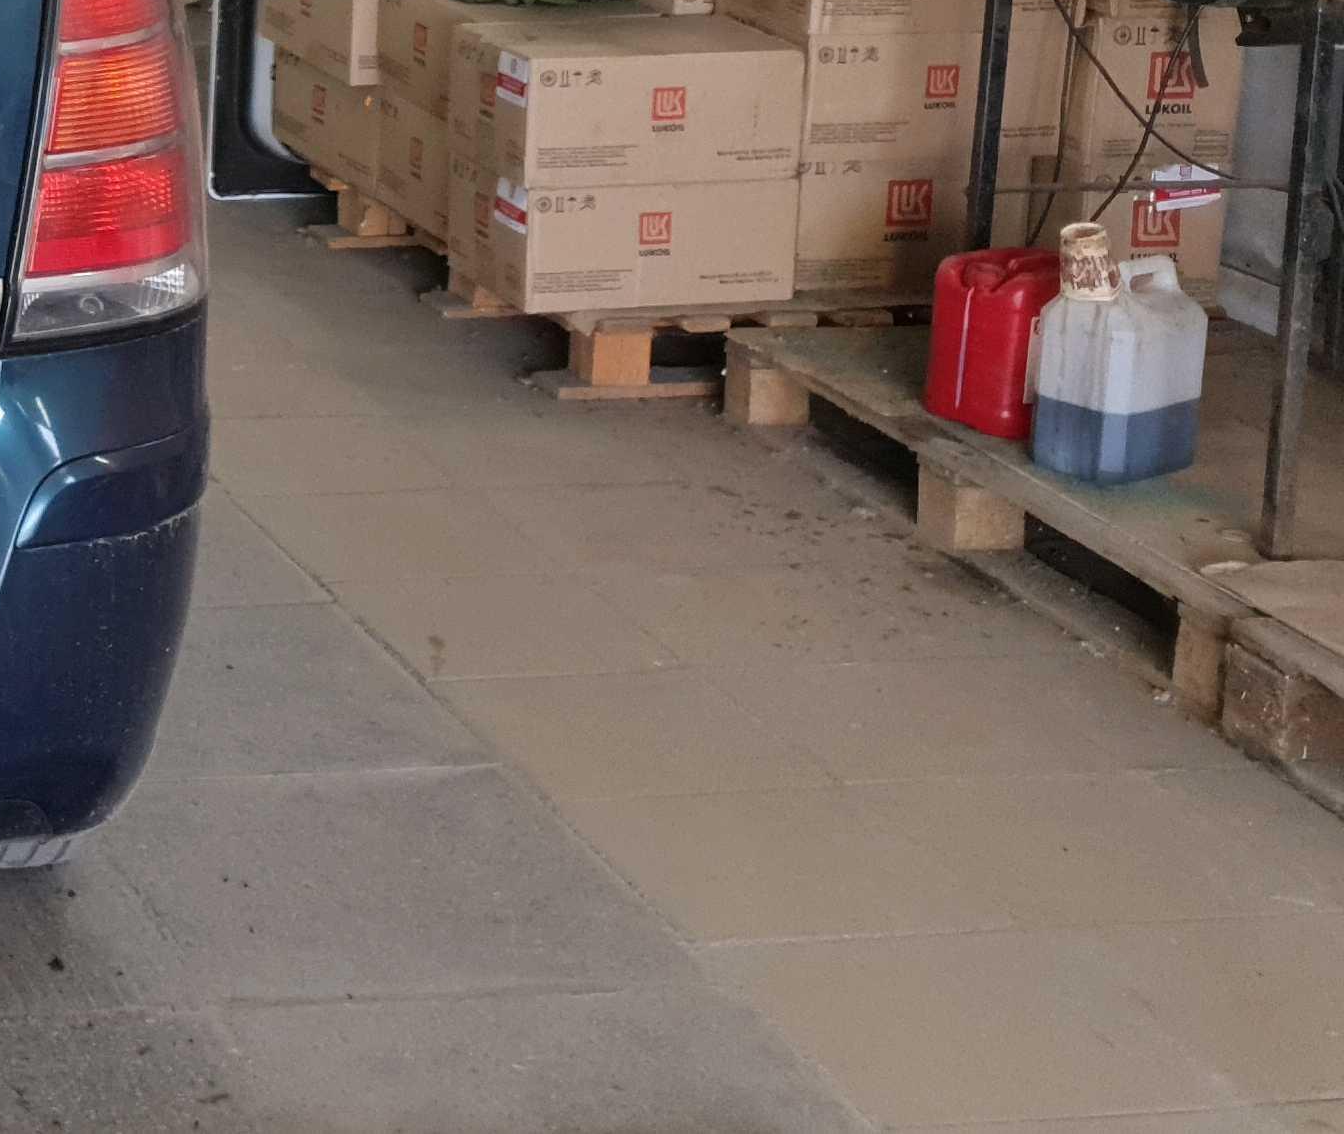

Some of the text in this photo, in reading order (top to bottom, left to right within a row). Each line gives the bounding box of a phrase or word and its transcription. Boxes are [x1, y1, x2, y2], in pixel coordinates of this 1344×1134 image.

[926, 67, 959, 96] LUK
[653, 89, 685, 118] LUK
[1145, 103, 1193, 115] LKOIL
[887, 181, 932, 224] LUK
[640, 214, 671, 243] LUK
